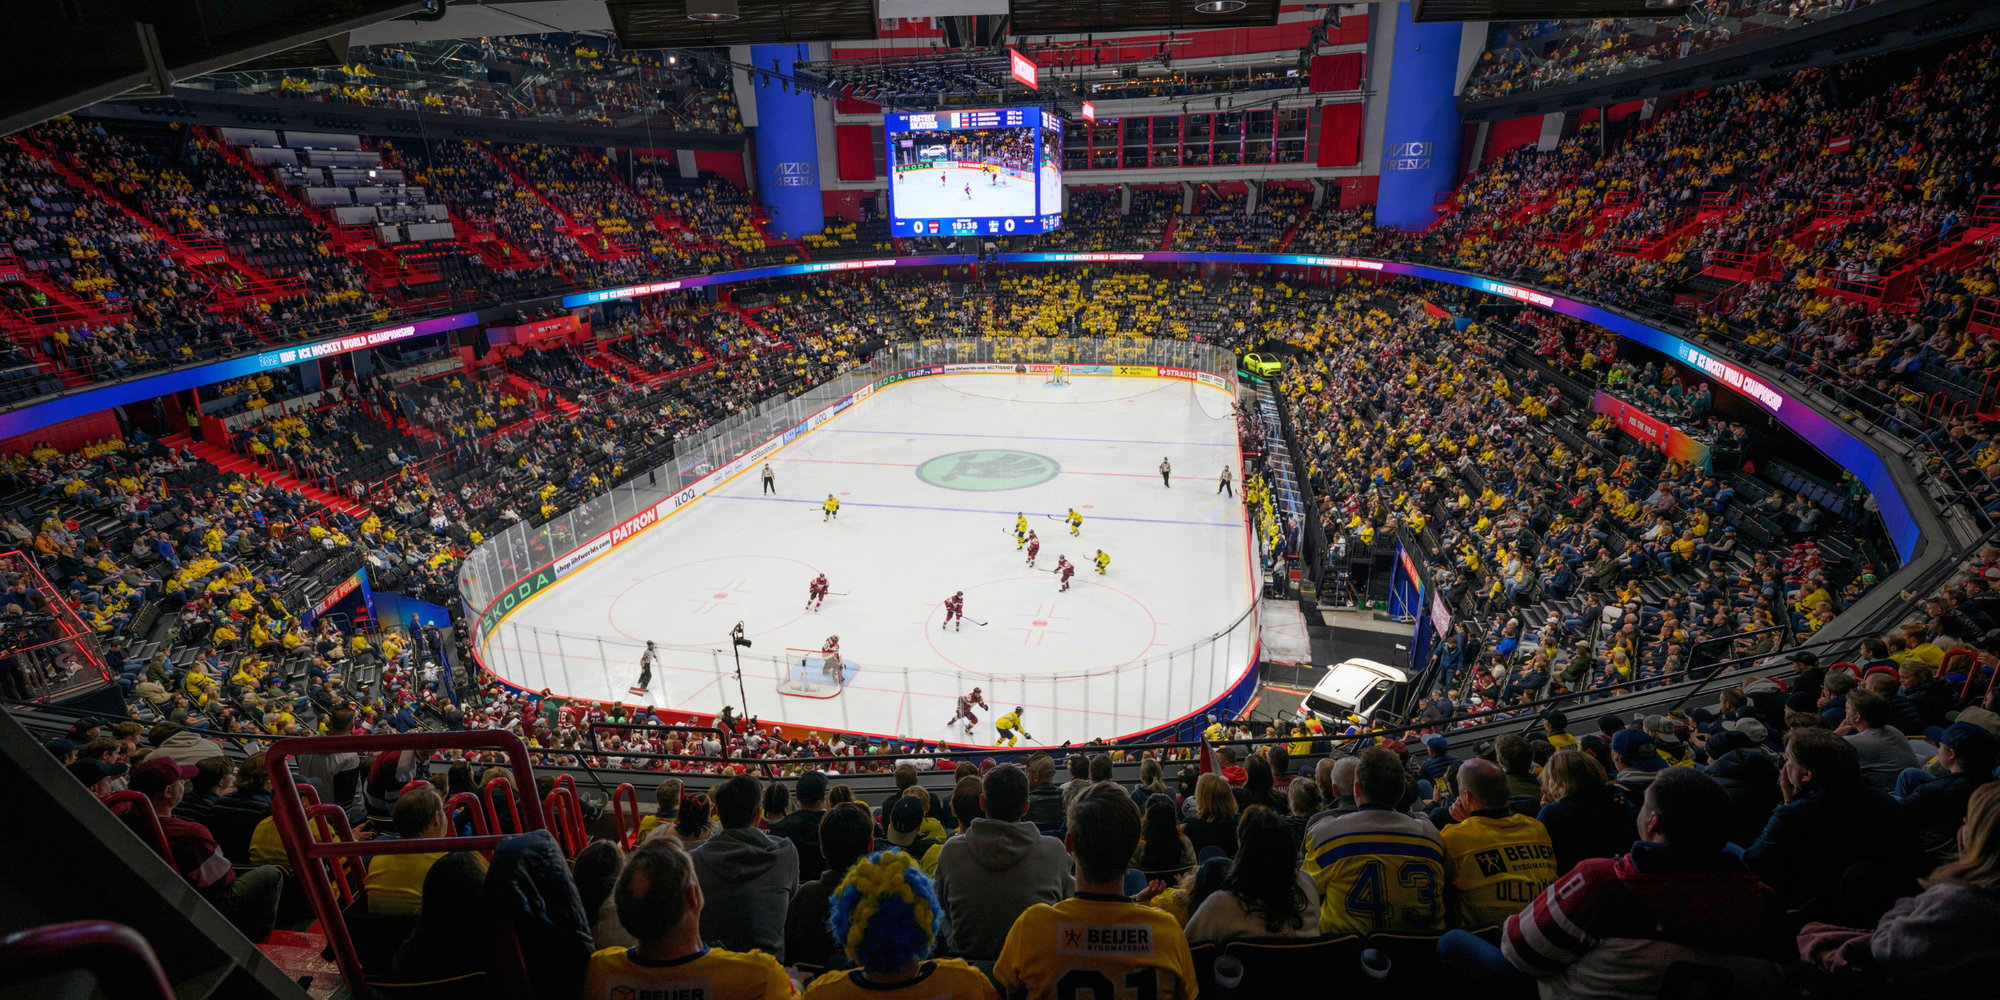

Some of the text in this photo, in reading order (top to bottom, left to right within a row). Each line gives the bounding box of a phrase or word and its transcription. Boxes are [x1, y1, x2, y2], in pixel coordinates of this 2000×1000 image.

[914, 219, 1015, 233] 0 19:35 0
[259, 355, 279, 366] 2025
[298, 348, 312, 359] ICE
[312, 342, 342, 356] HOCKEY
[342, 336, 367, 349] WORLD
[368, 326, 415, 344] CHAMPIONSHIP
[1166, 369, 1196, 380] STRAUSS
[756, 442, 777, 459] Stockholm
[674, 488, 696, 508] iLOQ
[612, 509, 656, 545] PATRON
[327, 591, 339, 605] THE
[339, 576, 357, 596] PULSE
[1504, 844, 1555, 861] BEIJER
[1345, 860, 1440, 930] 43
[1087, 928, 1149, 944] BEIJER
[640, 988, 704, 1000] BEIJER
